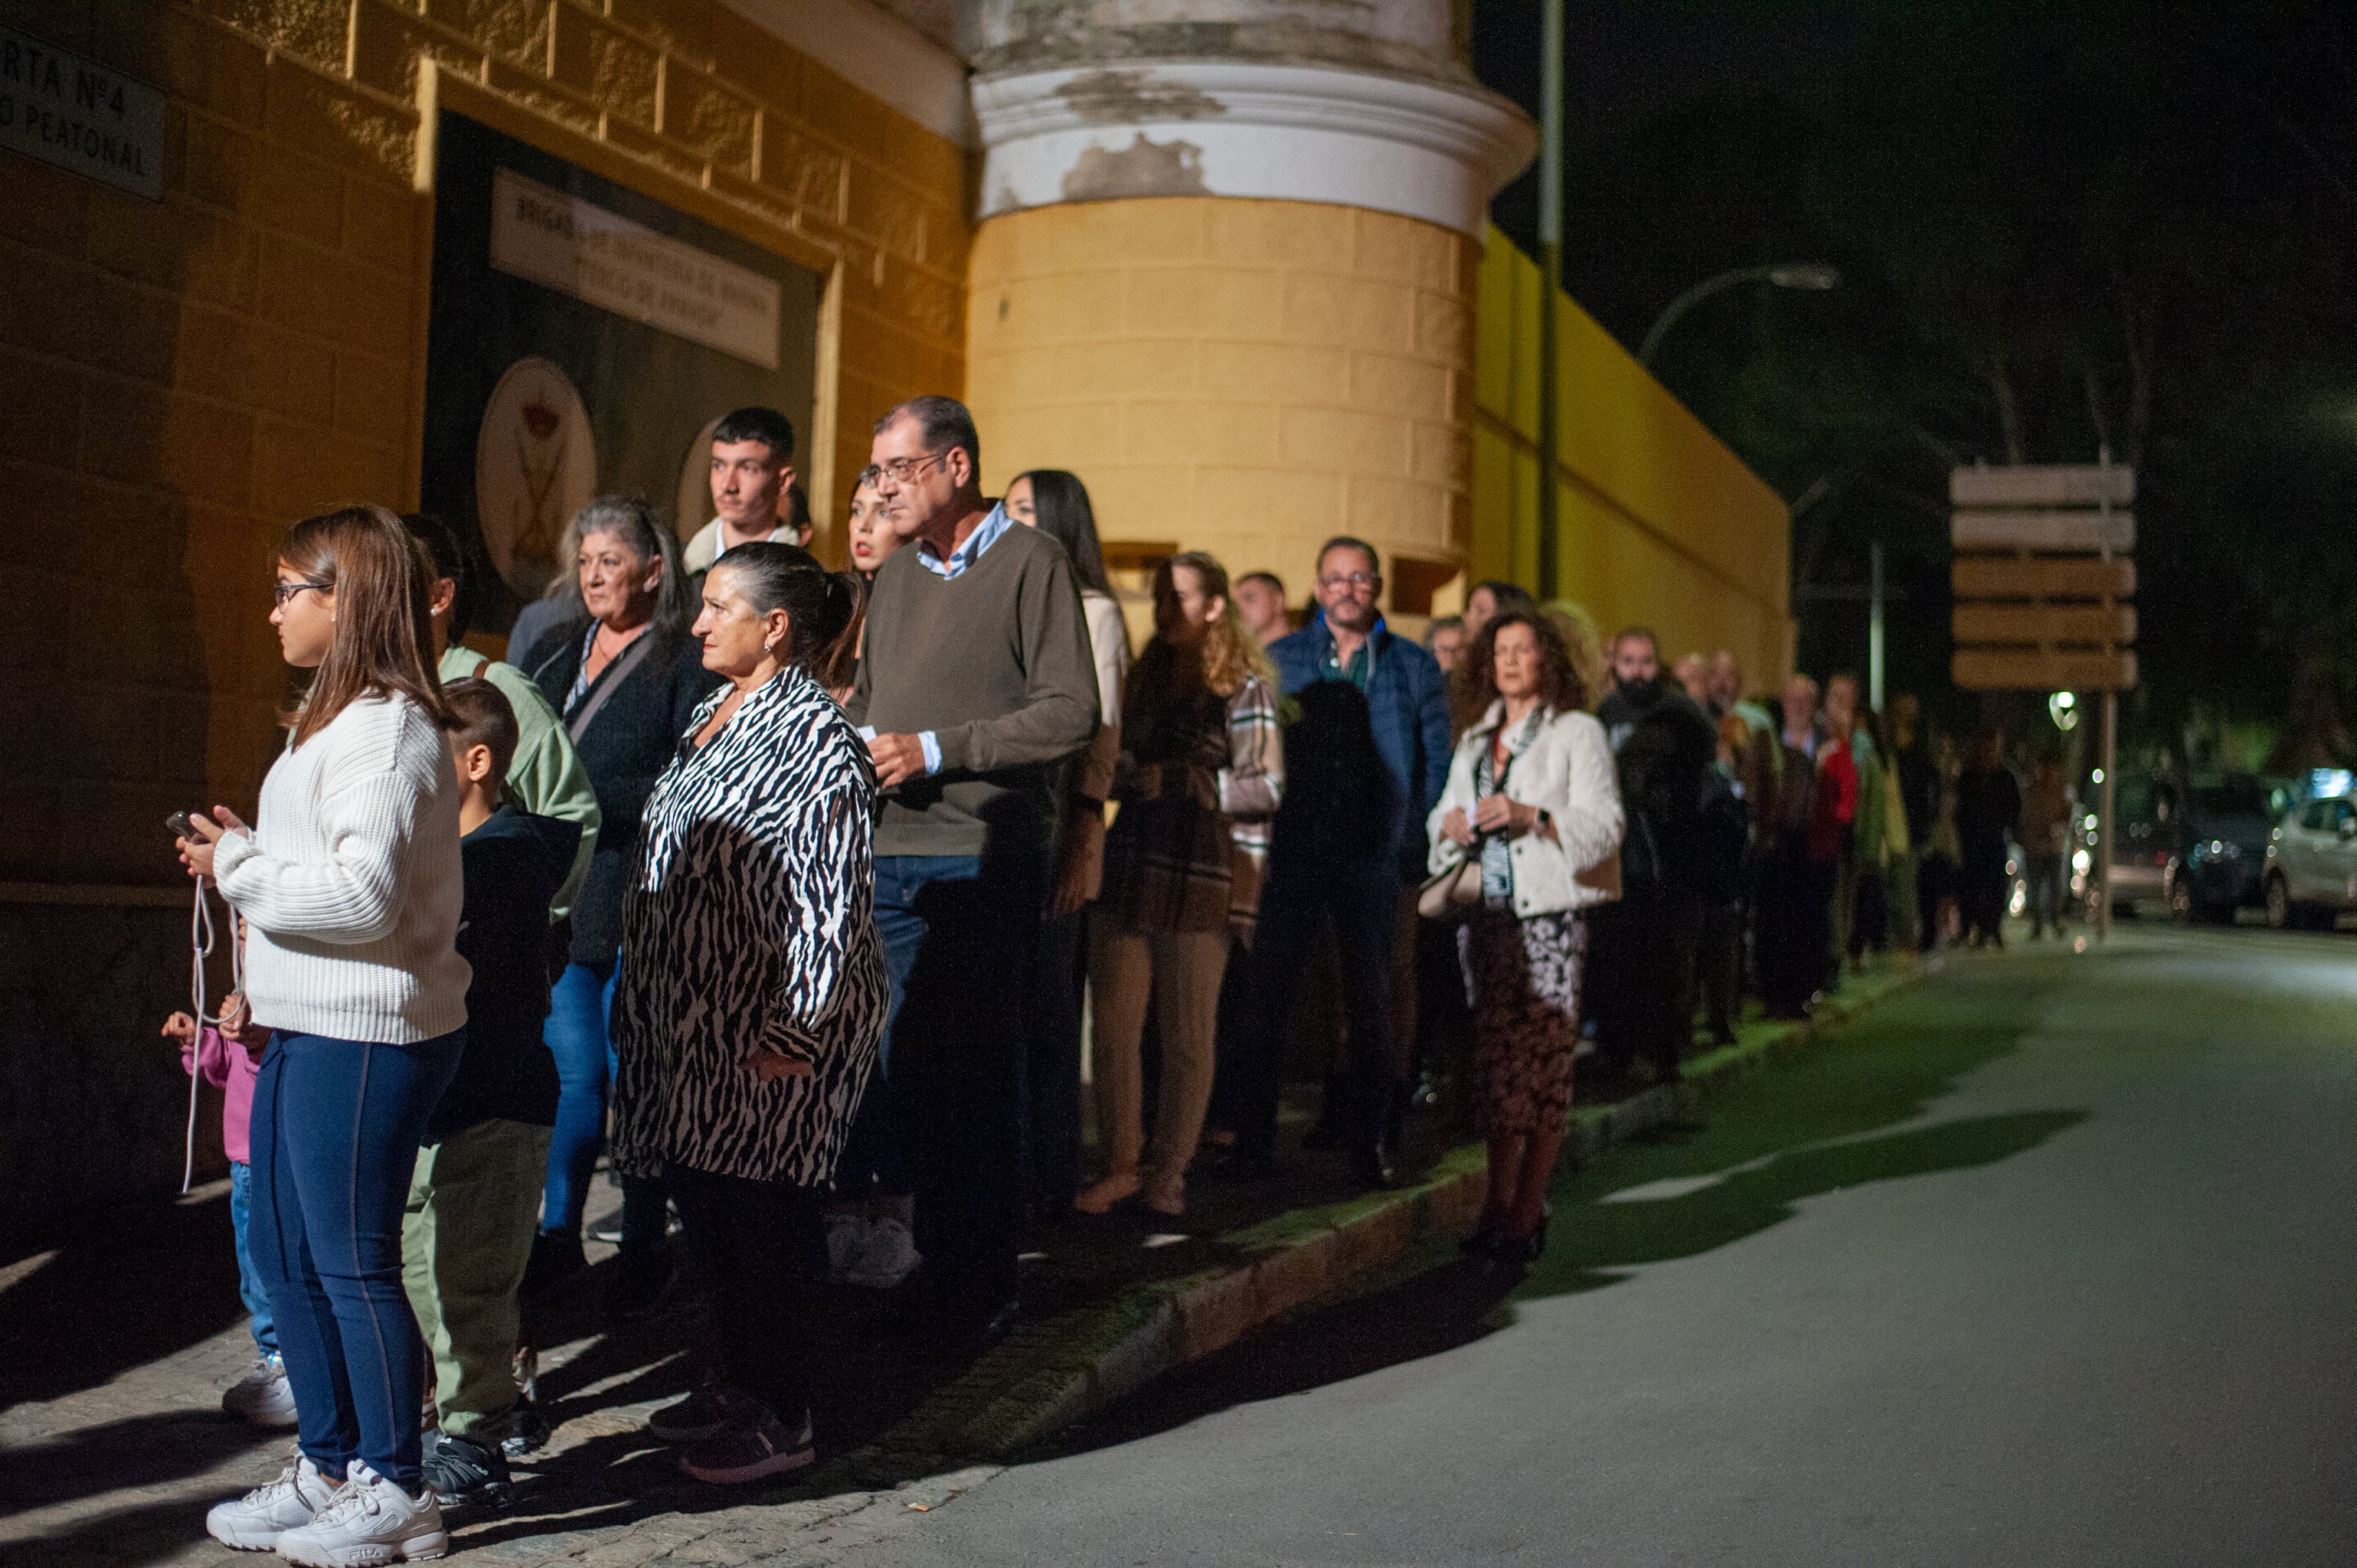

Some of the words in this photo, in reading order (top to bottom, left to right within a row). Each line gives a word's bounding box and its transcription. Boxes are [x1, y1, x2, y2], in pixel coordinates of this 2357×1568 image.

[3, 40, 61, 98] RTA
[25, 106, 145, 176] PEATONAL
[348, 1547, 383, 1560] FILA
